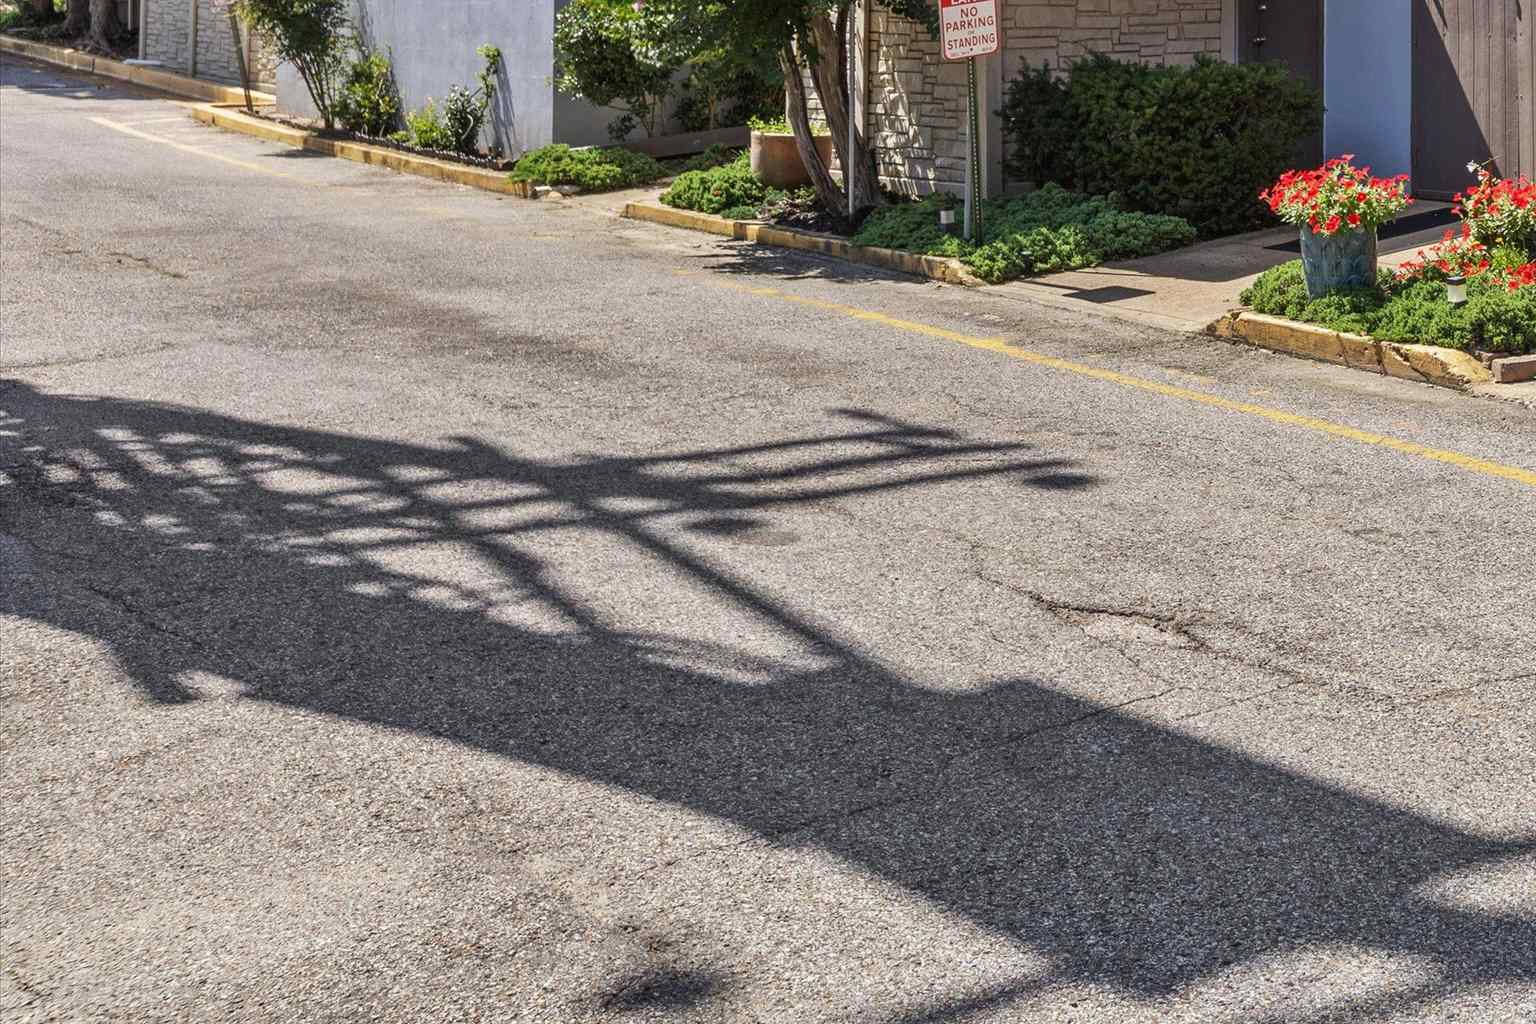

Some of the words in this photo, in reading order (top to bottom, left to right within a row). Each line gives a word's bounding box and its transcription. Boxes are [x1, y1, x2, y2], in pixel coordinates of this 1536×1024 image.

[960, 6, 978, 18] NO
[946, 16, 994, 32] PARKING
[947, 33, 996, 50] STANDING
